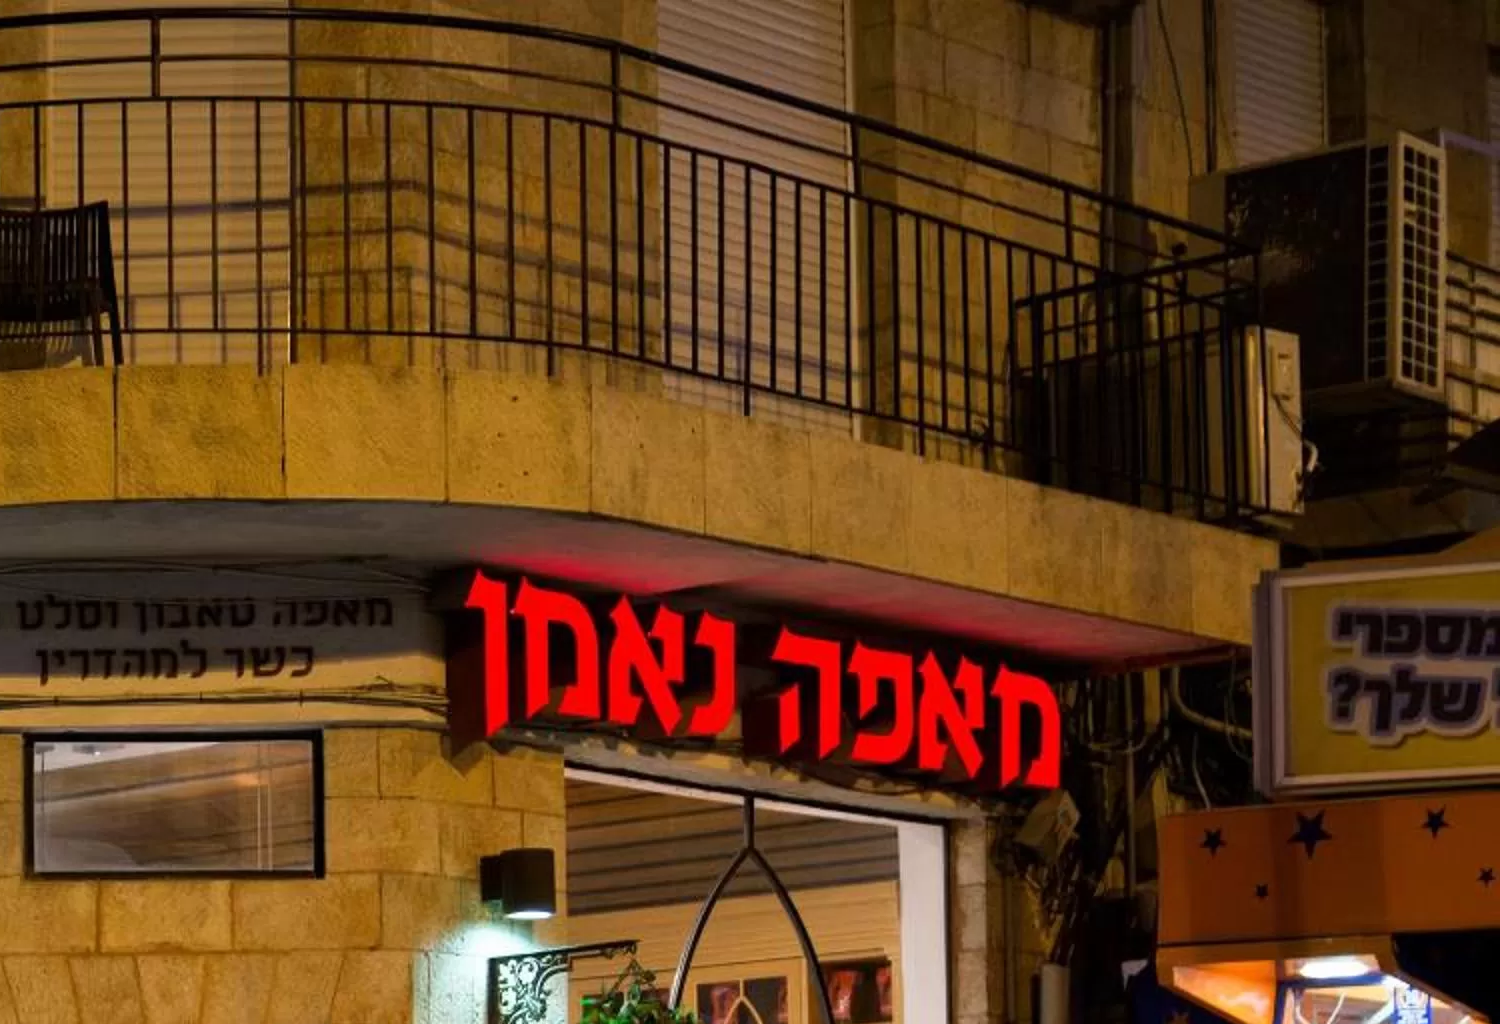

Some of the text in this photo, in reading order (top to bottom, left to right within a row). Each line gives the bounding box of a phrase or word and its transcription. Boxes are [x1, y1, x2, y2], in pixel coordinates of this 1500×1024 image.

[17, 593, 118, 633] וסלט
[137, 597, 256, 634] טאבון
[272, 597, 394, 628] מאפה
[36, 637, 316, 687] כשר למהדרין
[466, 568, 1060, 789] מאפה נאמן
[1331, 667, 1484, 733] שלך?
